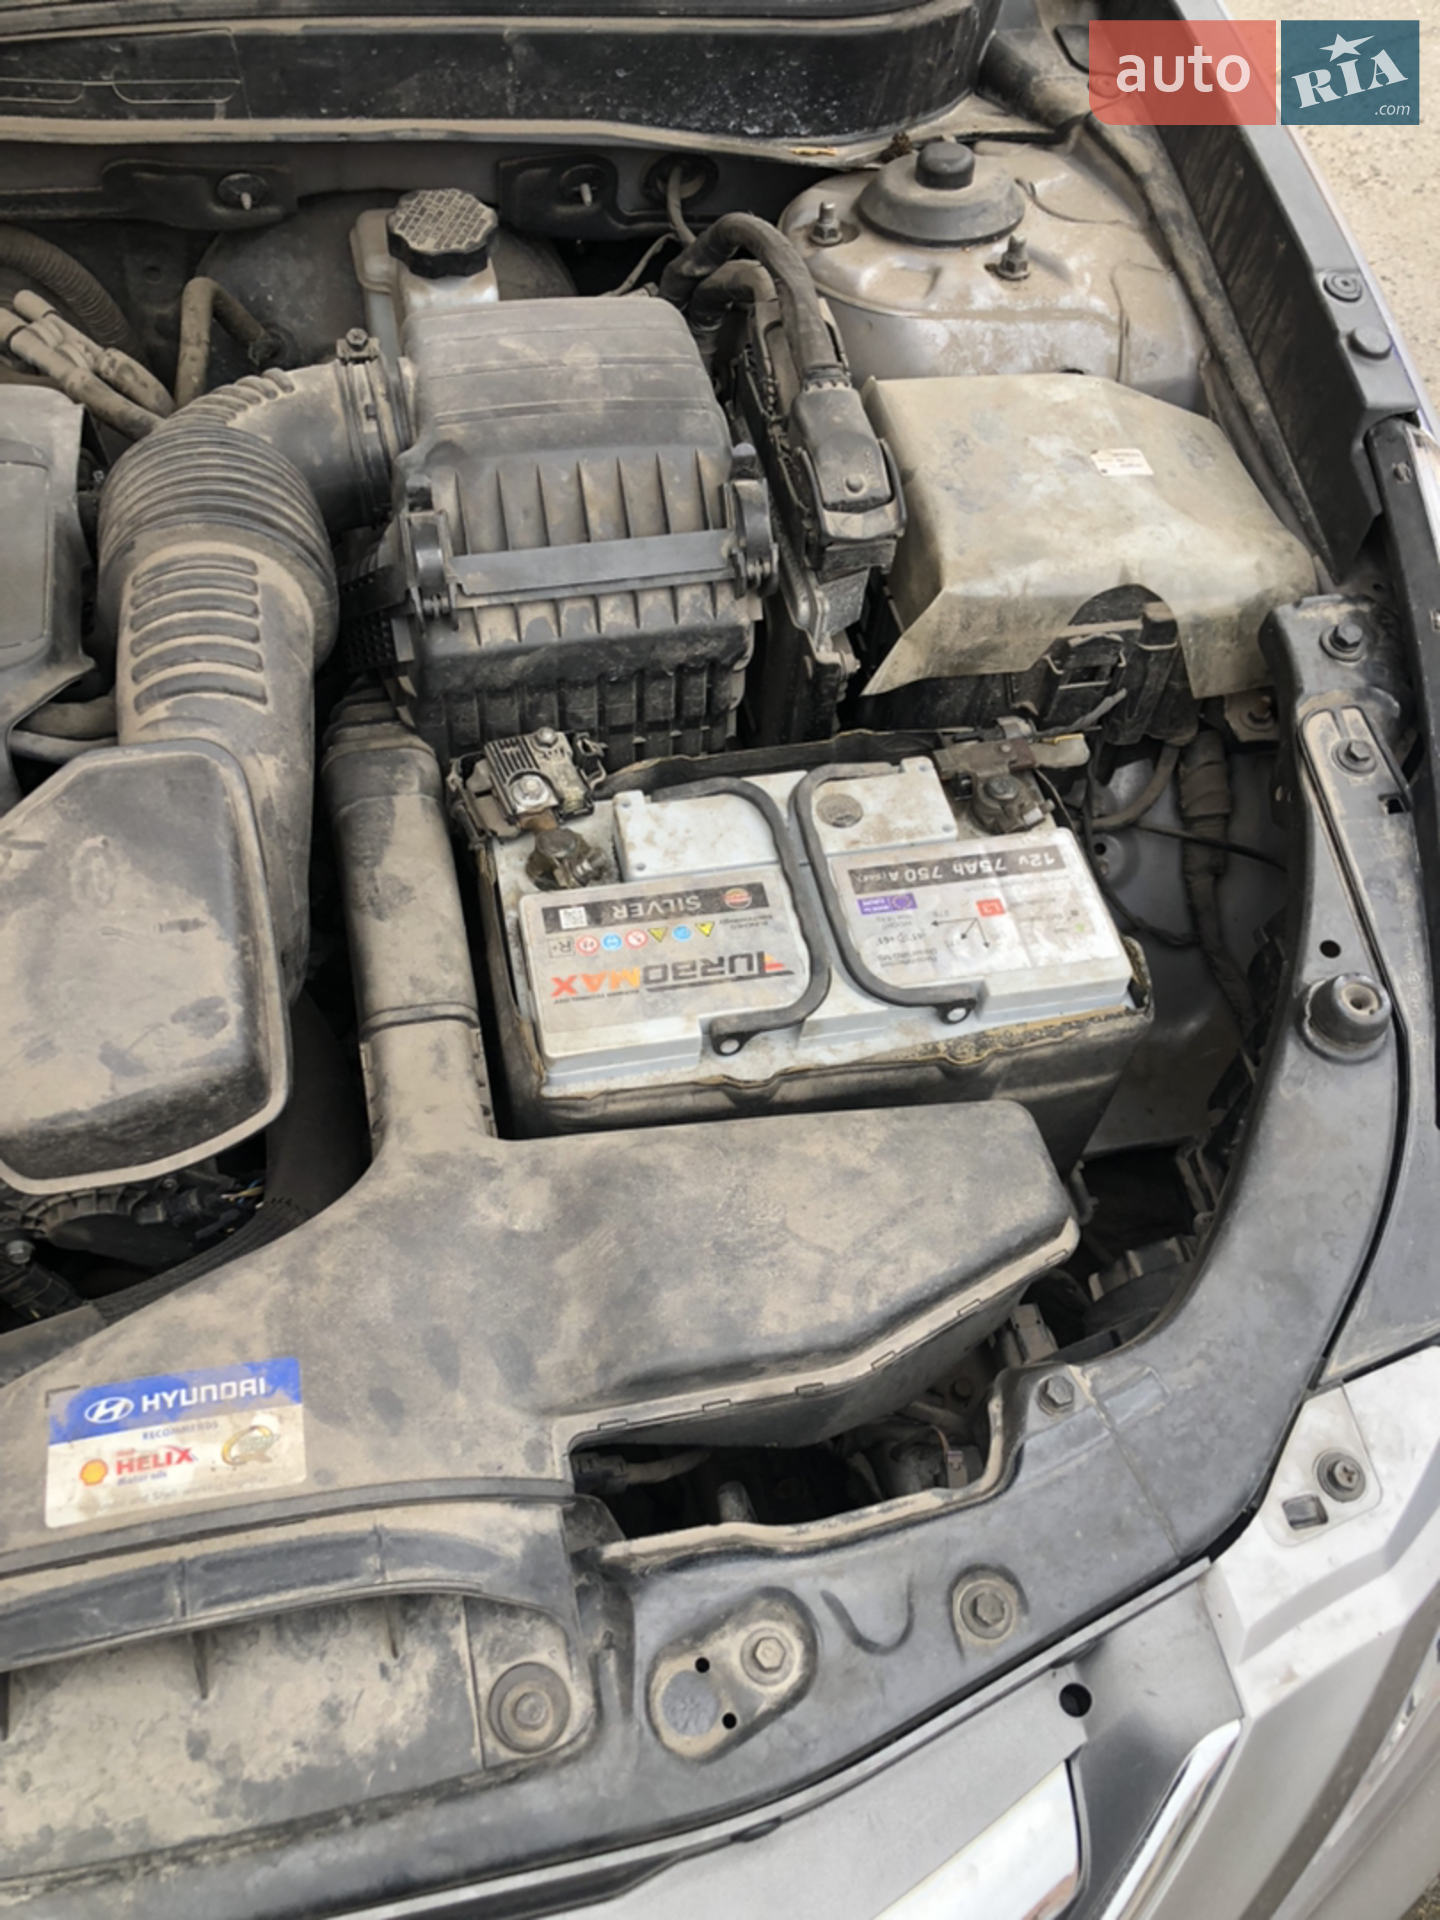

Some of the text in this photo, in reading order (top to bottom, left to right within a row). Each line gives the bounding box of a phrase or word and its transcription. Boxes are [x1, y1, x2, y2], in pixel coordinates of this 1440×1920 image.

[904, 865, 943, 883] 750
[953, 858, 1006, 874] 75Ah
[611, 893, 701, 920] SILVER
[141, 1377, 266, 1413] HYUNDAI
[116, 1446, 194, 1475] HELIX
